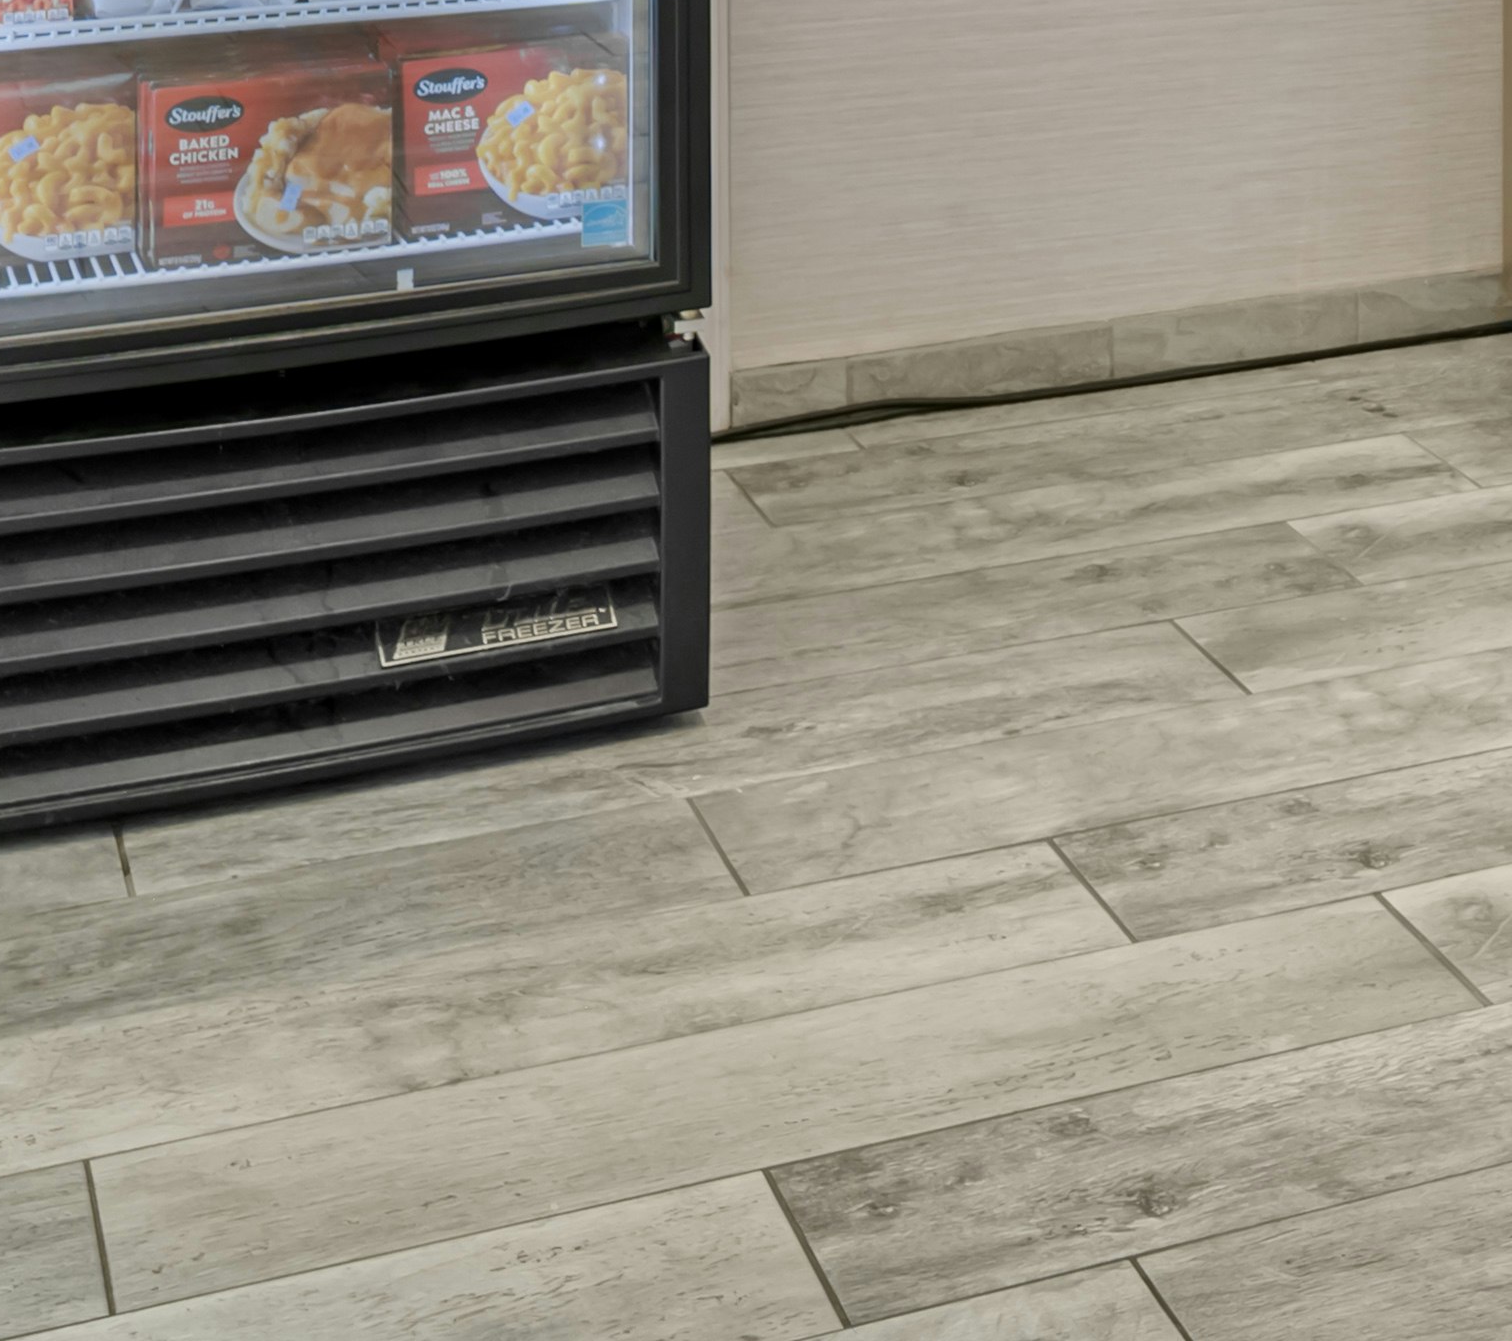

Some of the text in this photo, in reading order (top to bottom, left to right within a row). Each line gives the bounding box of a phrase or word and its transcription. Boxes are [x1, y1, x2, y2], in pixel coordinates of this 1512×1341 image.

[417, 76, 485, 97] Stouffer's
[169, 105, 241, 125] Stouffer's
[428, 106, 475, 121] MAC &
[424, 118, 479, 135] CHEESE
[179, 135, 230, 150] BAKED
[169, 148, 238, 165] CHICKEN
[481, 614, 599, 644] FREEZER
